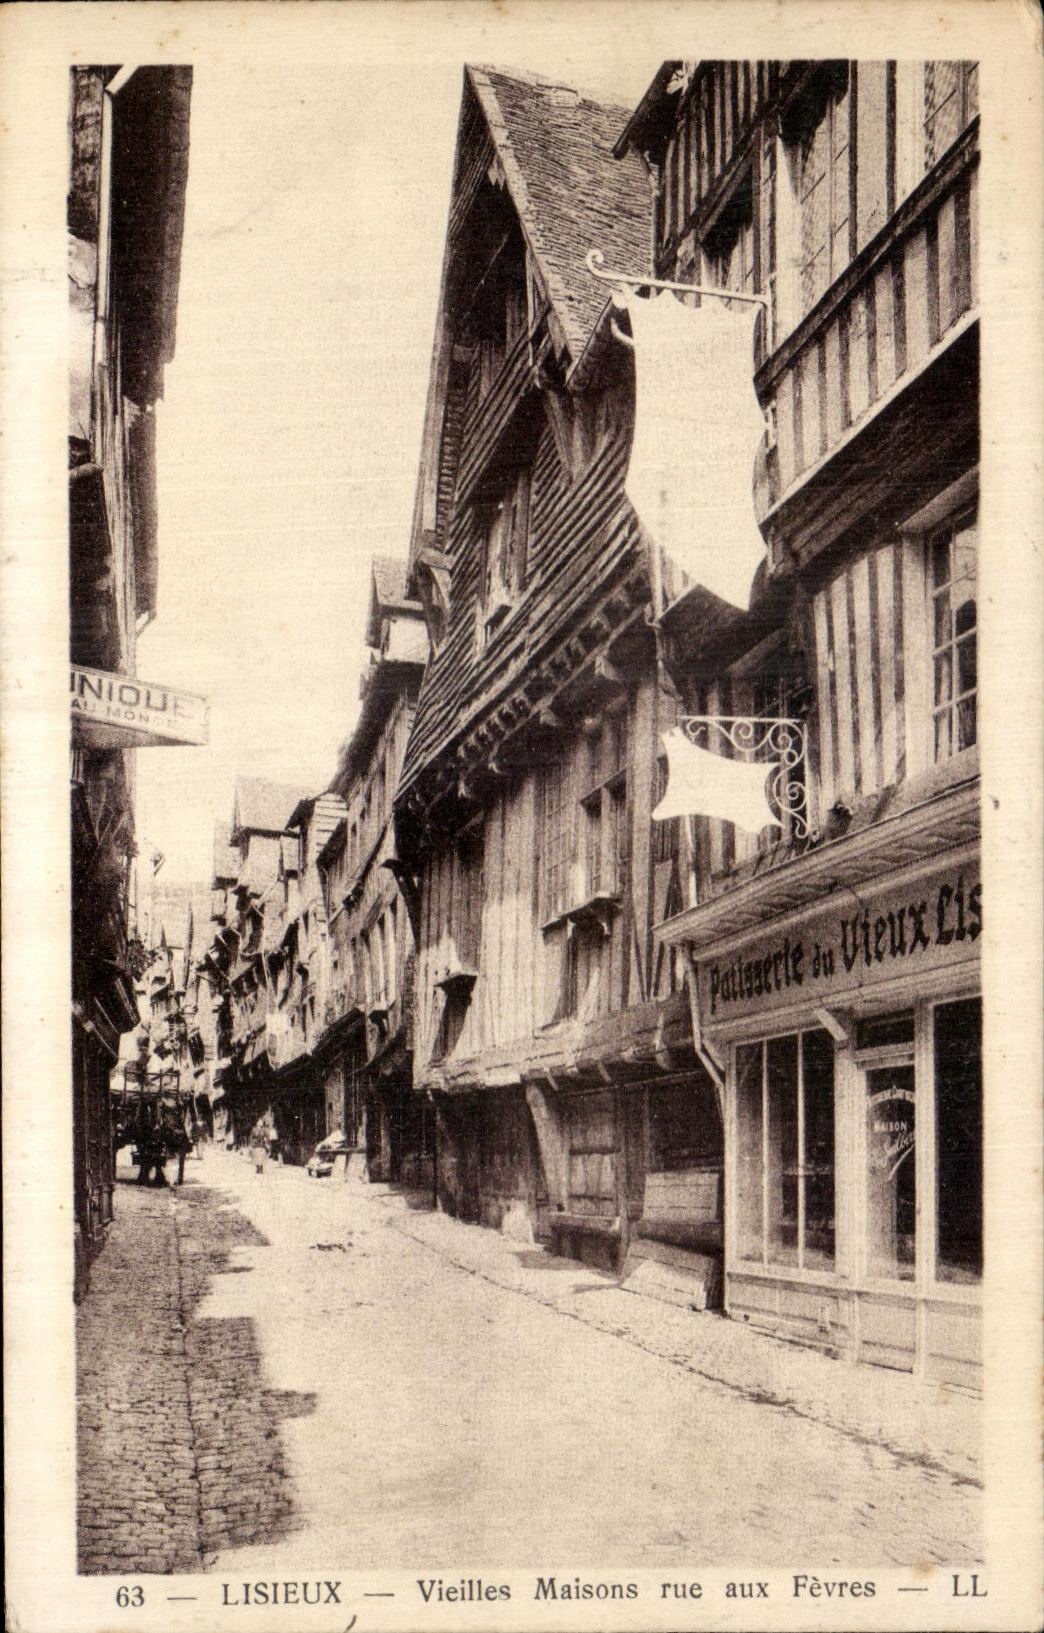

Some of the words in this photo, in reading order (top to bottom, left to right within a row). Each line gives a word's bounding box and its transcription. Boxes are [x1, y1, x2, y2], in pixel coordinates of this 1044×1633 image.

[69, 671, 195, 719] NIQUE
[811, 942, 835, 980] du
[840, 905, 931, 973] Vieux
